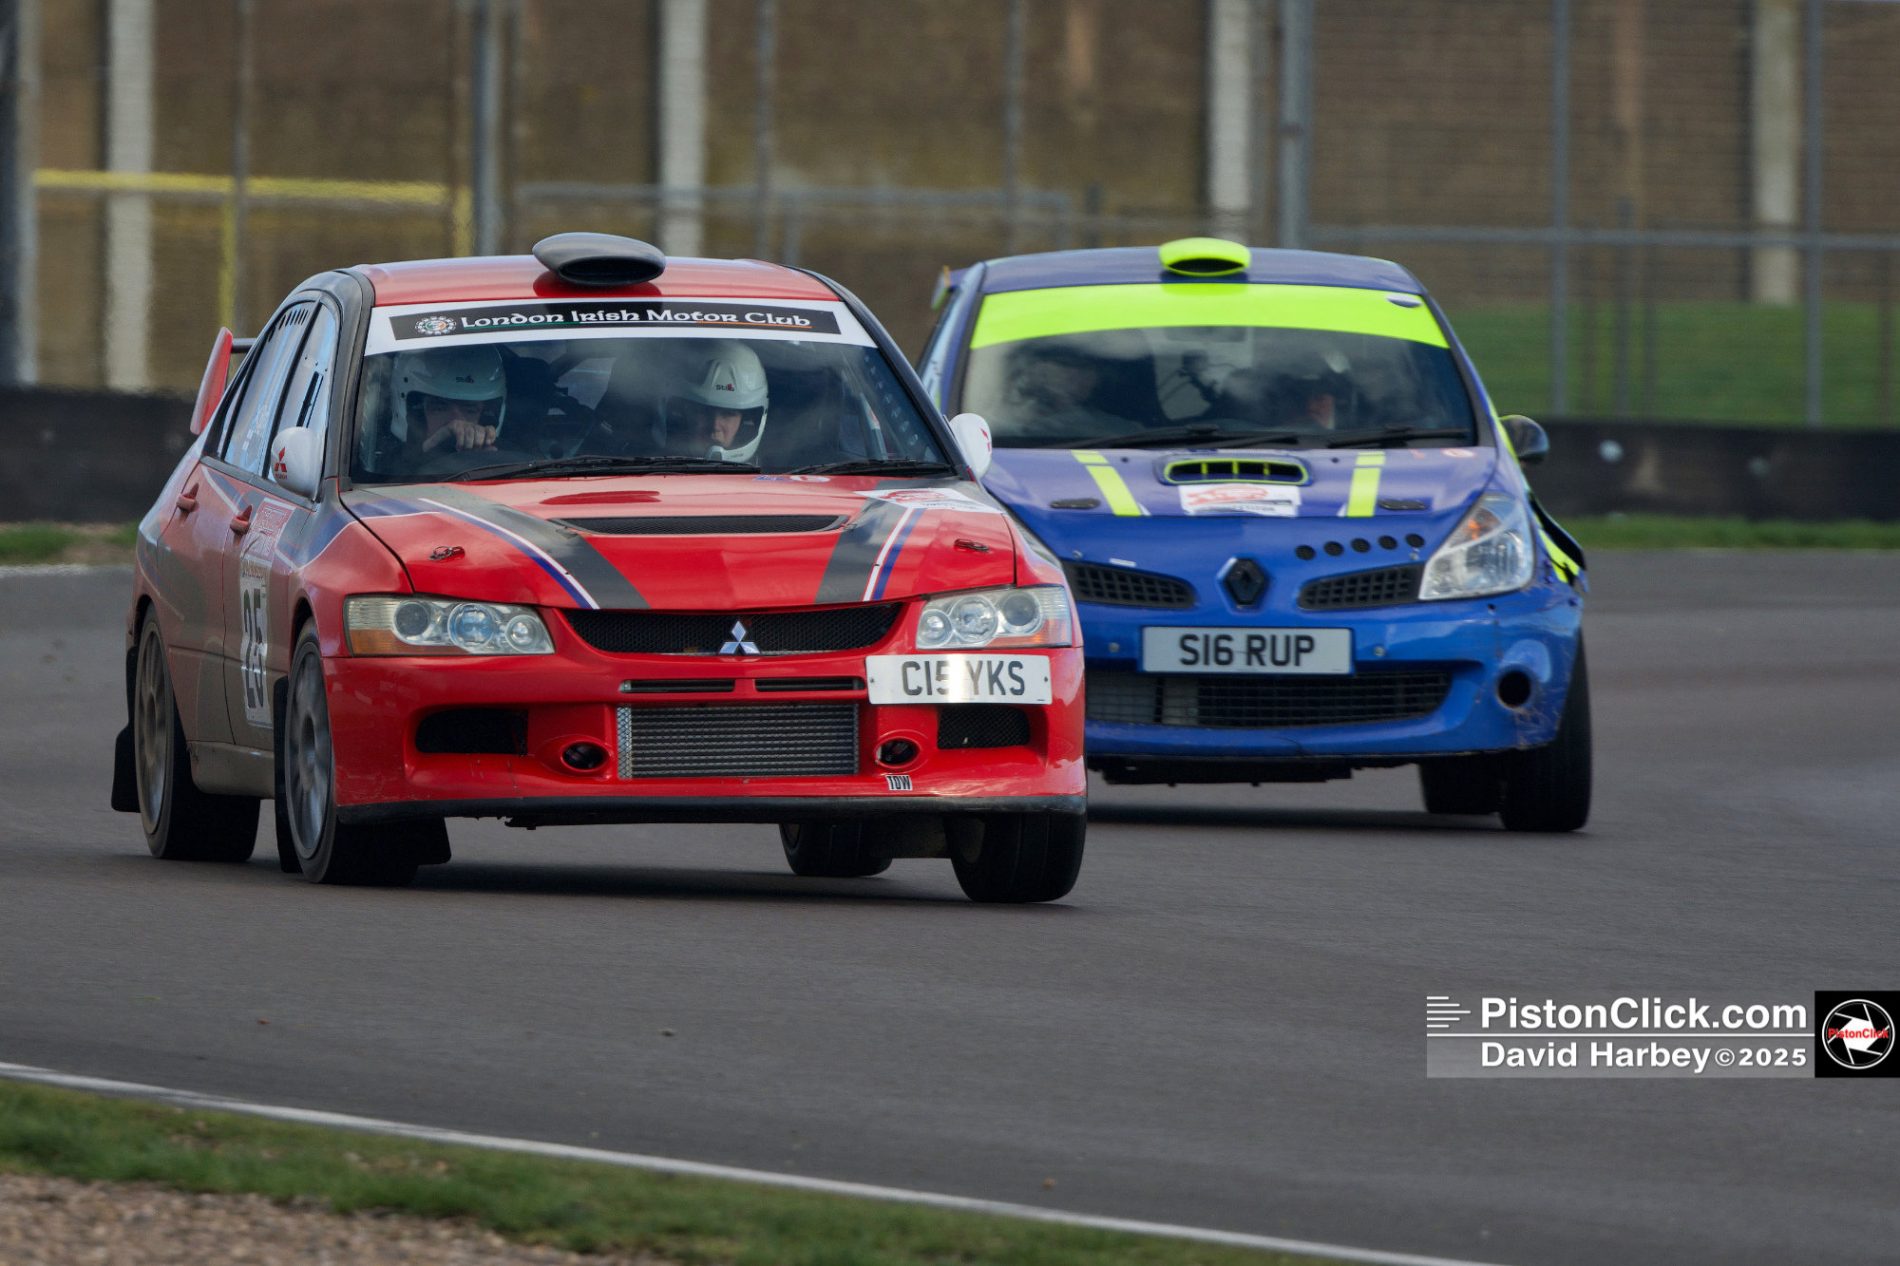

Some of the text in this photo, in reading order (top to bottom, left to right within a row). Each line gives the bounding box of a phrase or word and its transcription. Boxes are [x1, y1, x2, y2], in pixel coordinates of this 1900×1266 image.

[461, 309, 811, 328] London Irish Motor Club
[1179, 633, 1315, 666] S16 RUP
[966, 661, 1025, 696] YKS
[887, 776, 911, 790] TOW
